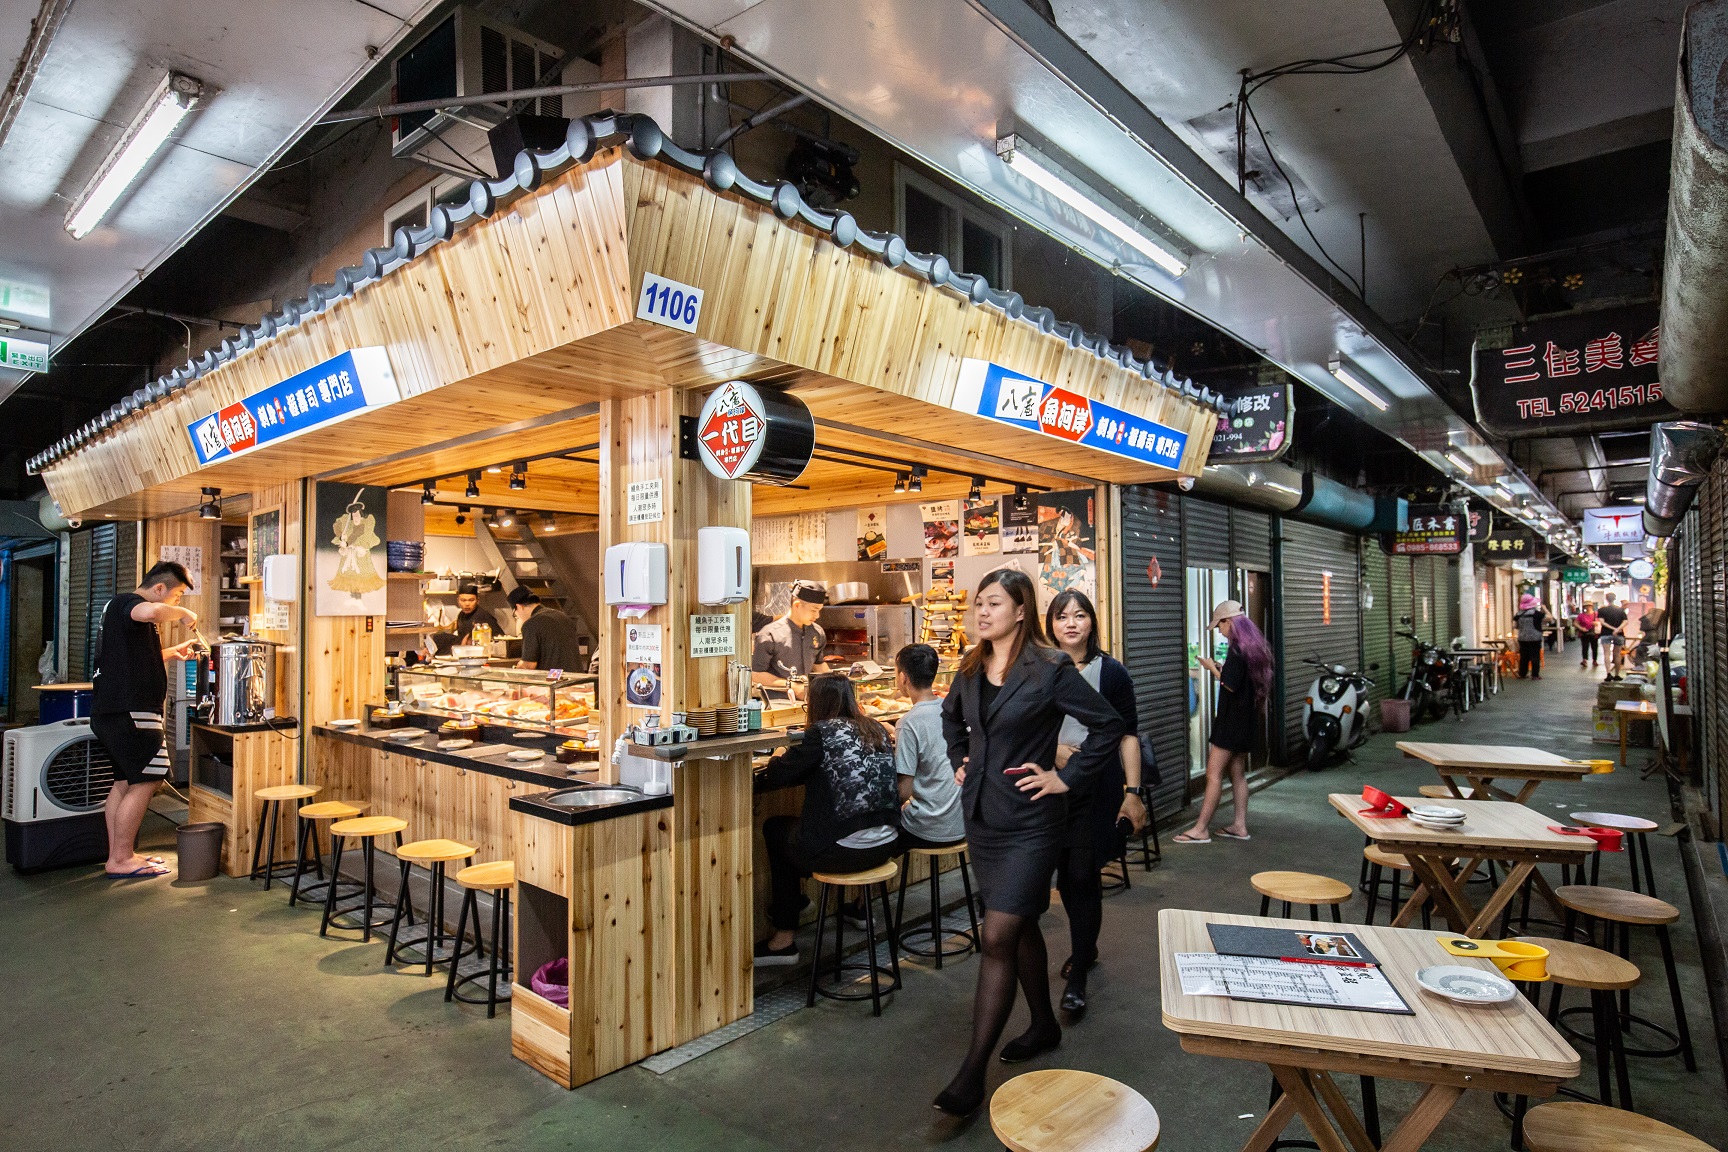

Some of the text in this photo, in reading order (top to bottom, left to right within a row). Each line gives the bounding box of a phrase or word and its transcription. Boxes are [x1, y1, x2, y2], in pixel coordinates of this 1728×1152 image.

[645, 282, 698, 325] 1106
[12, 359, 42, 368] EXIT
[221, 411, 254, 446] 魚河岸
[318, 370, 353, 403] 專門店
[1516, 383, 1663, 419] TEL 5241515
[703, 416, 759, 446] 一代目
[1042, 398, 1089, 434] 魚河岸
[1155, 436, 1180, 459] 專門店
[695, 625, 731, 634] 每日限量供應
